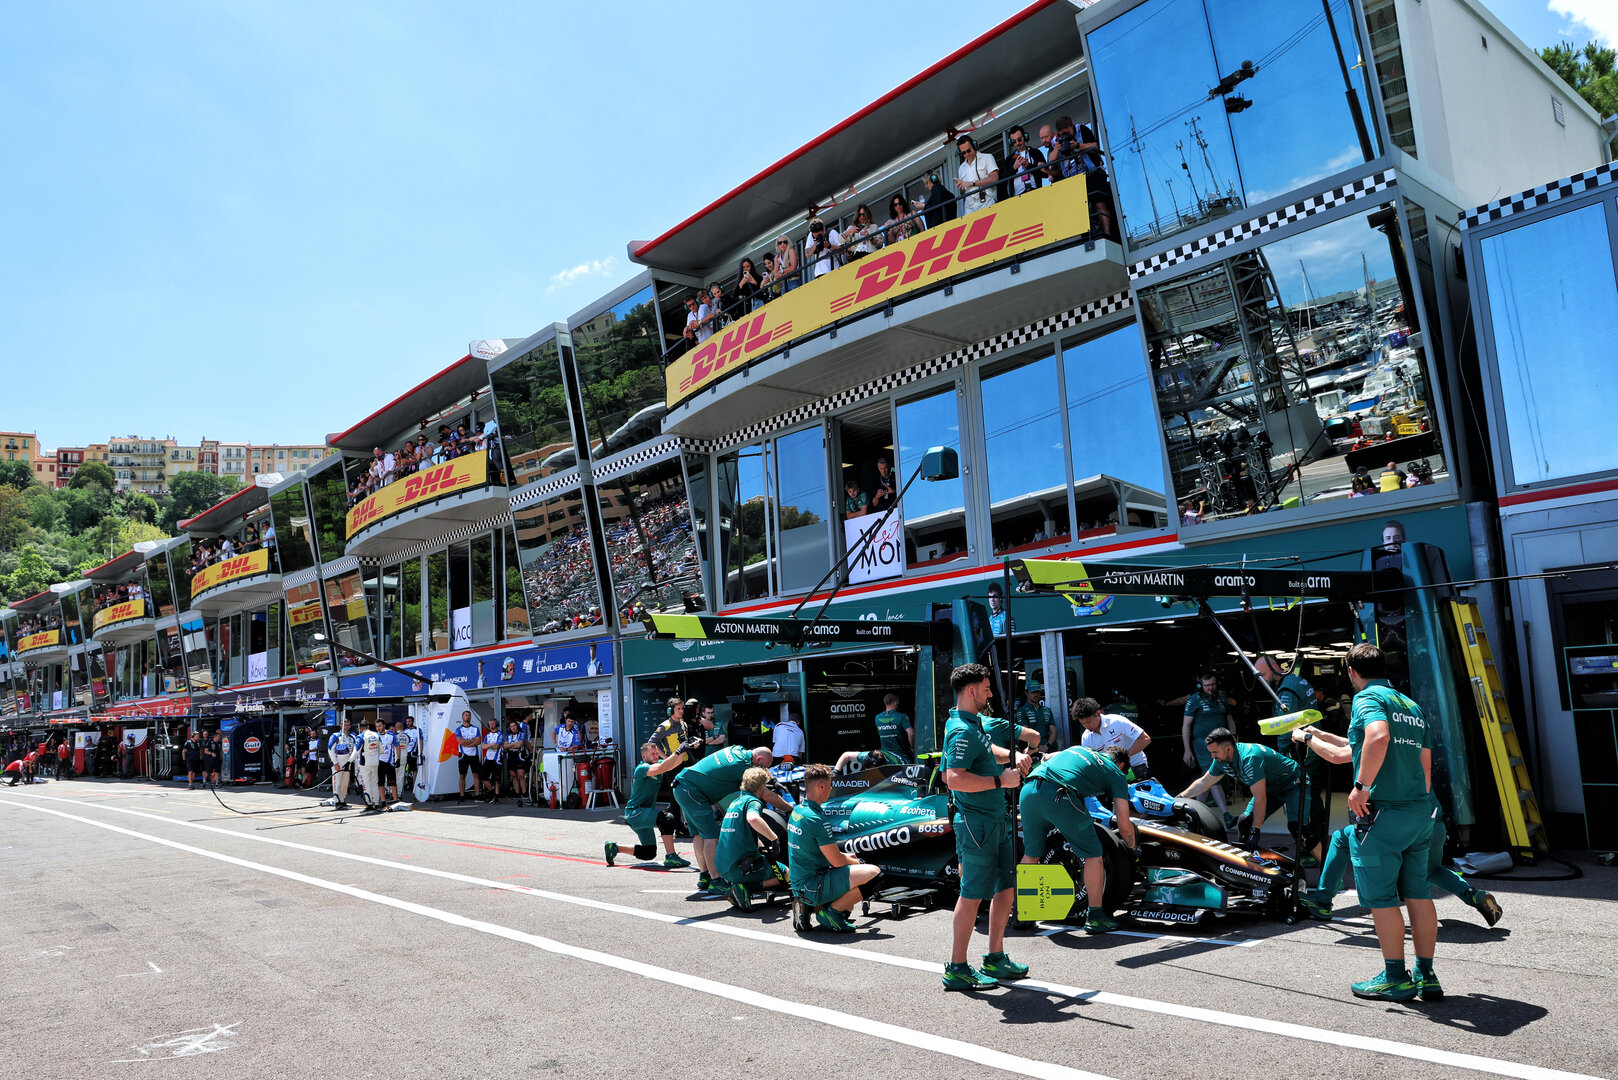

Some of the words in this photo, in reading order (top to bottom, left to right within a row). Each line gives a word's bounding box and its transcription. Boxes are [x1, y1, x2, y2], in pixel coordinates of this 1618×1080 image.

[854, 212, 1010, 304] DHL
[476, 349, 501, 357] MONAC
[689, 312, 774, 387] DHL
[404, 464, 458, 502] DHL
[352, 497, 378, 530] DHL
[220, 556, 251, 577] DHL
[1103, 570, 1141, 585] ASTON
[1143, 573, 1185, 587] MARTIN
[1307, 576, 1331, 588] arm
[713, 622, 745, 634] ASTON
[746, 623, 780, 635] MARTIN
[803, 624, 840, 636] aramco
[872, 625, 892, 636] arm
[682, 655, 698, 663] FORMULA
[536, 661, 578, 674] LINDBLAD
[830, 703, 866, 713] aramco
[832, 780, 870, 788] MAADEN
[890, 775, 918, 788] CoreWeave
[906, 806, 936, 816] cohere
[918, 824, 945, 834] BOSS
[844, 826, 911, 855] aramco
[1165, 851, 1180, 859] FIA
[1224, 866, 1272, 885] COINPAYMENTS
[1045, 885, 1051, 899] ON
[1130, 909, 1196, 922] GLENFIDDICH
